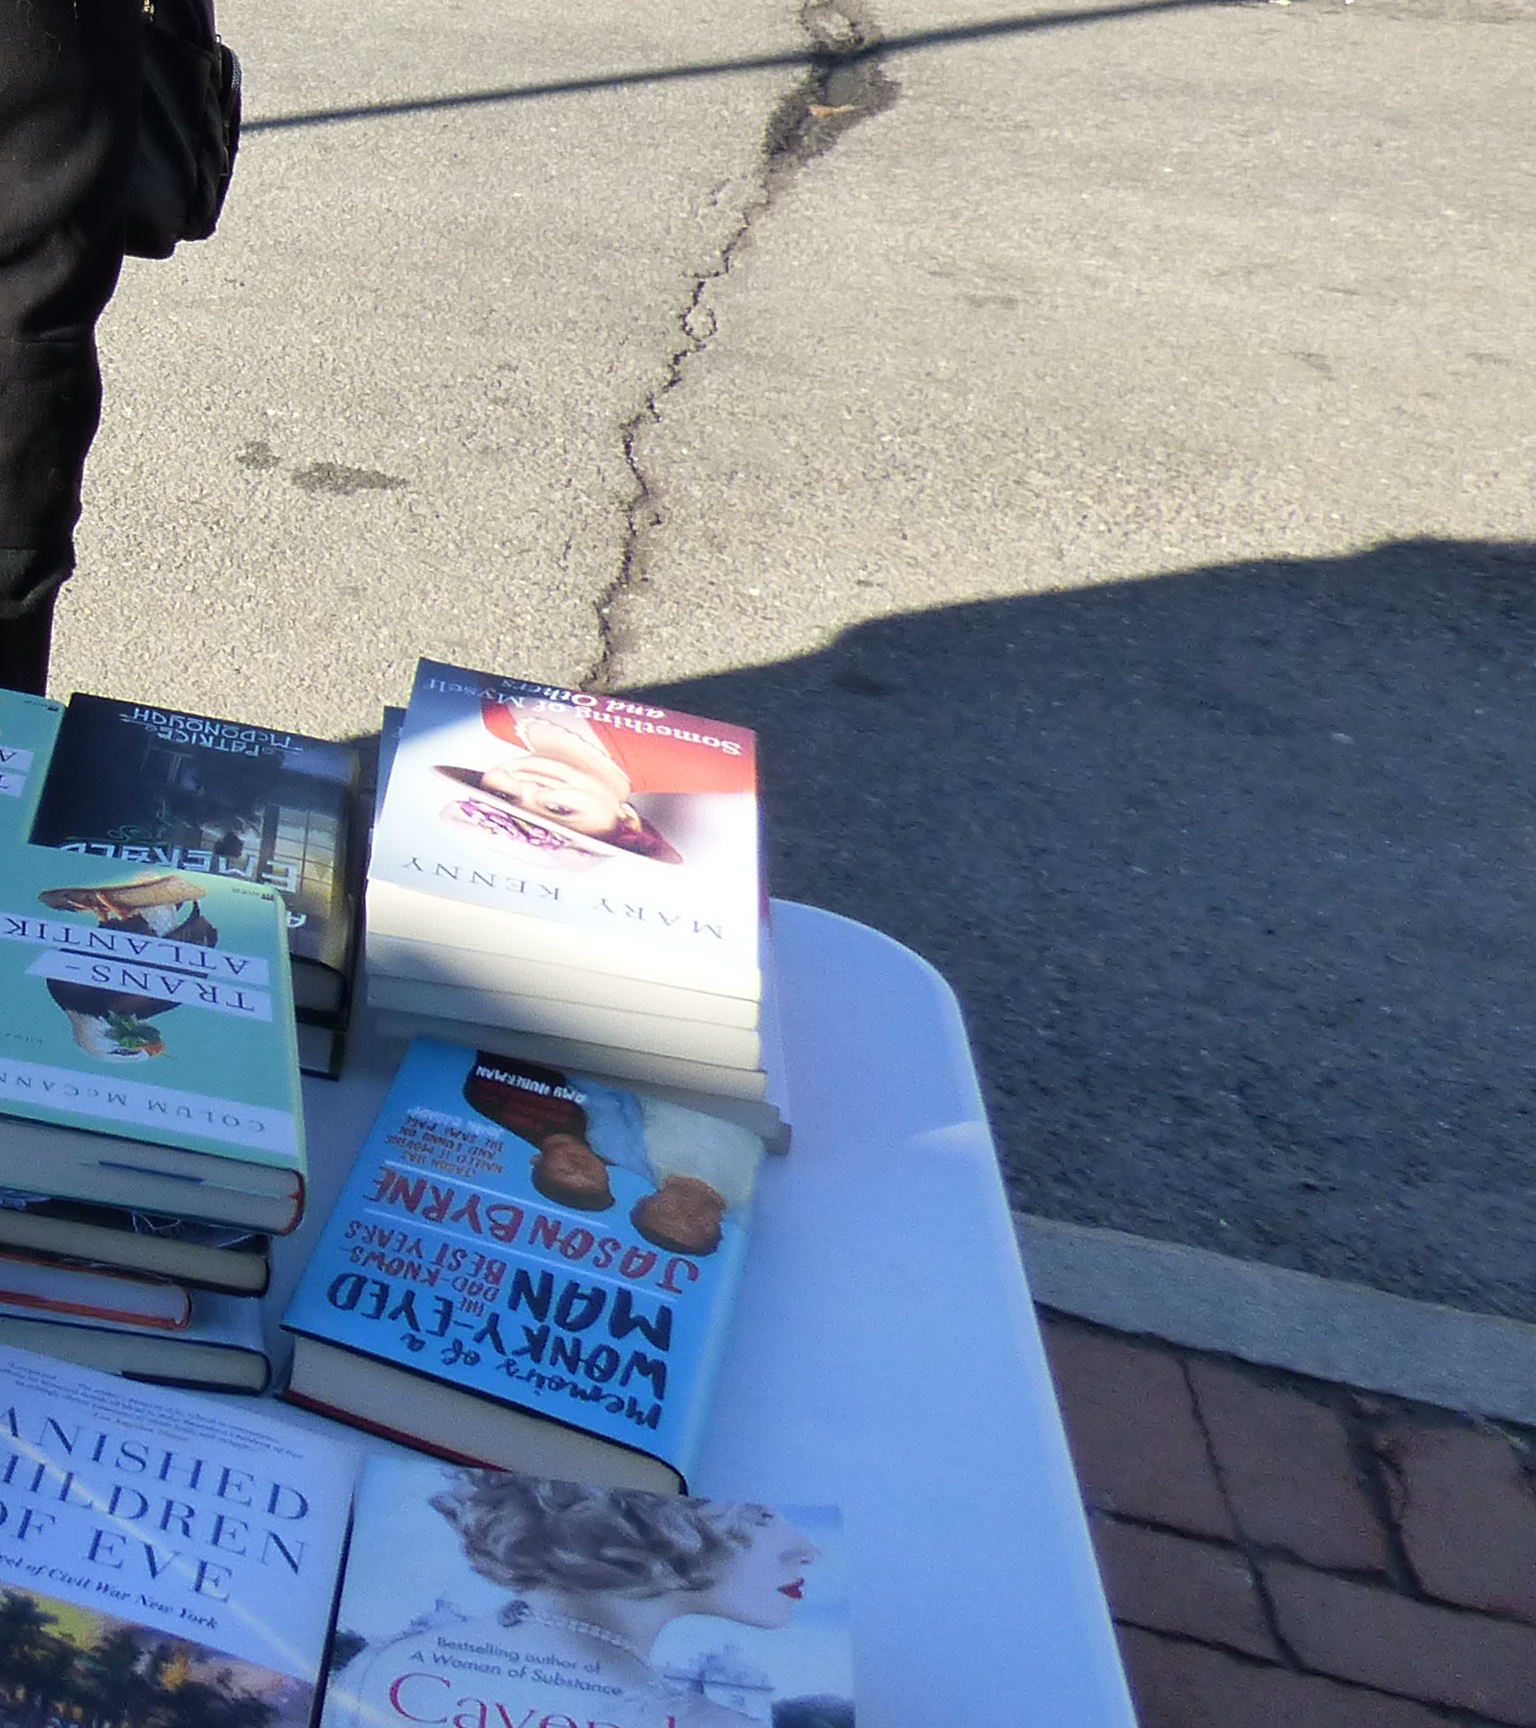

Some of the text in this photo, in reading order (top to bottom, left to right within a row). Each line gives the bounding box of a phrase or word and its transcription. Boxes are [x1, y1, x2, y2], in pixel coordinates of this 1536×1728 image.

[133, 707, 293, 750] McDONOUGH
[423, 677, 743, 756] Something of Myself
[501, 677, 666, 720] and Others
[157, 726, 261, 757] PATRICE
[401, 855, 725, 941] MARY KENNY
[3, 916, 252, 976] ATLANTIK
[65, 963, 256, 1012] TRANS-
[475, 1064, 588, 1104] AMY HUBERMAN
[147, 1098, 266, 1134] COLUM
[344, 1219, 507, 1286] BEST YEARS
[362, 1165, 702, 1295] JASON BYRNE
[325, 1270, 669, 1399] WONKY-EYED
[508, 1269, 674, 1351] MAN
[25, 1555, 48, 1577] of
[48, 1566, 92, 1590] Civil
[95, 1578, 132, 1601] War
[134, 1592, 176, 1614] New
[178, 1605, 220, 1630] York
[82, 1527, 236, 1604] EVE
[409, 1649, 624, 1697] A Woman of Substance
[435, 1635, 602, 1675] Bestselling author of
